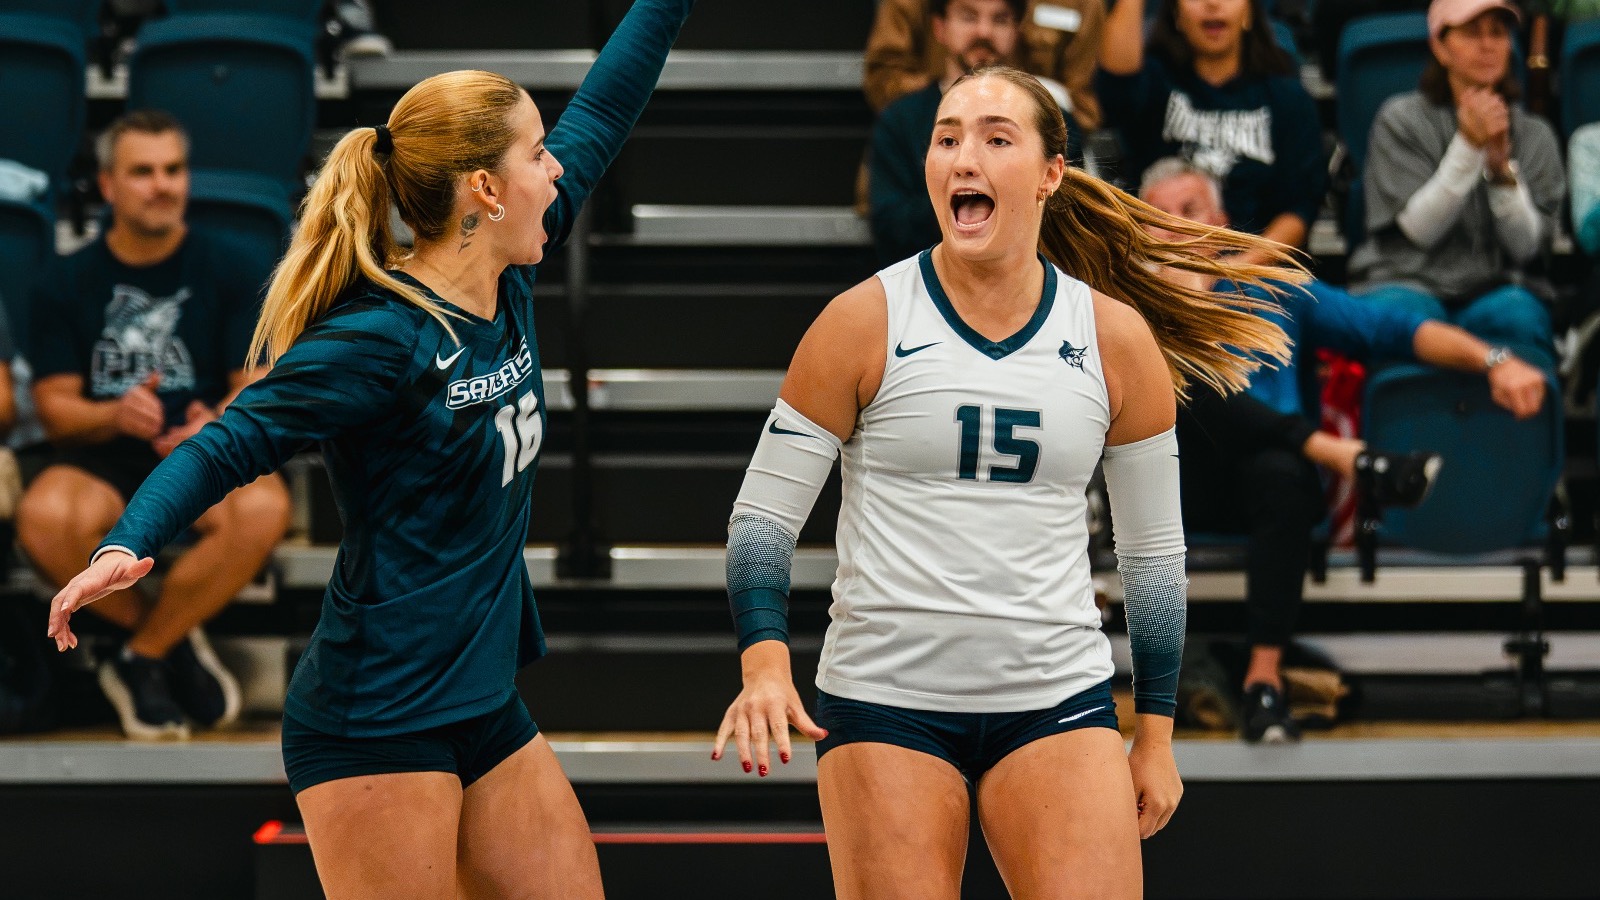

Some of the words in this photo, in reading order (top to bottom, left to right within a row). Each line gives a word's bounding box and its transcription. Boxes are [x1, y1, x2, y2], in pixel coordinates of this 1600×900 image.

[446, 338, 532, 409] SAILFIS
[495, 389, 542, 487] 16
[953, 402, 1043, 484] 15
